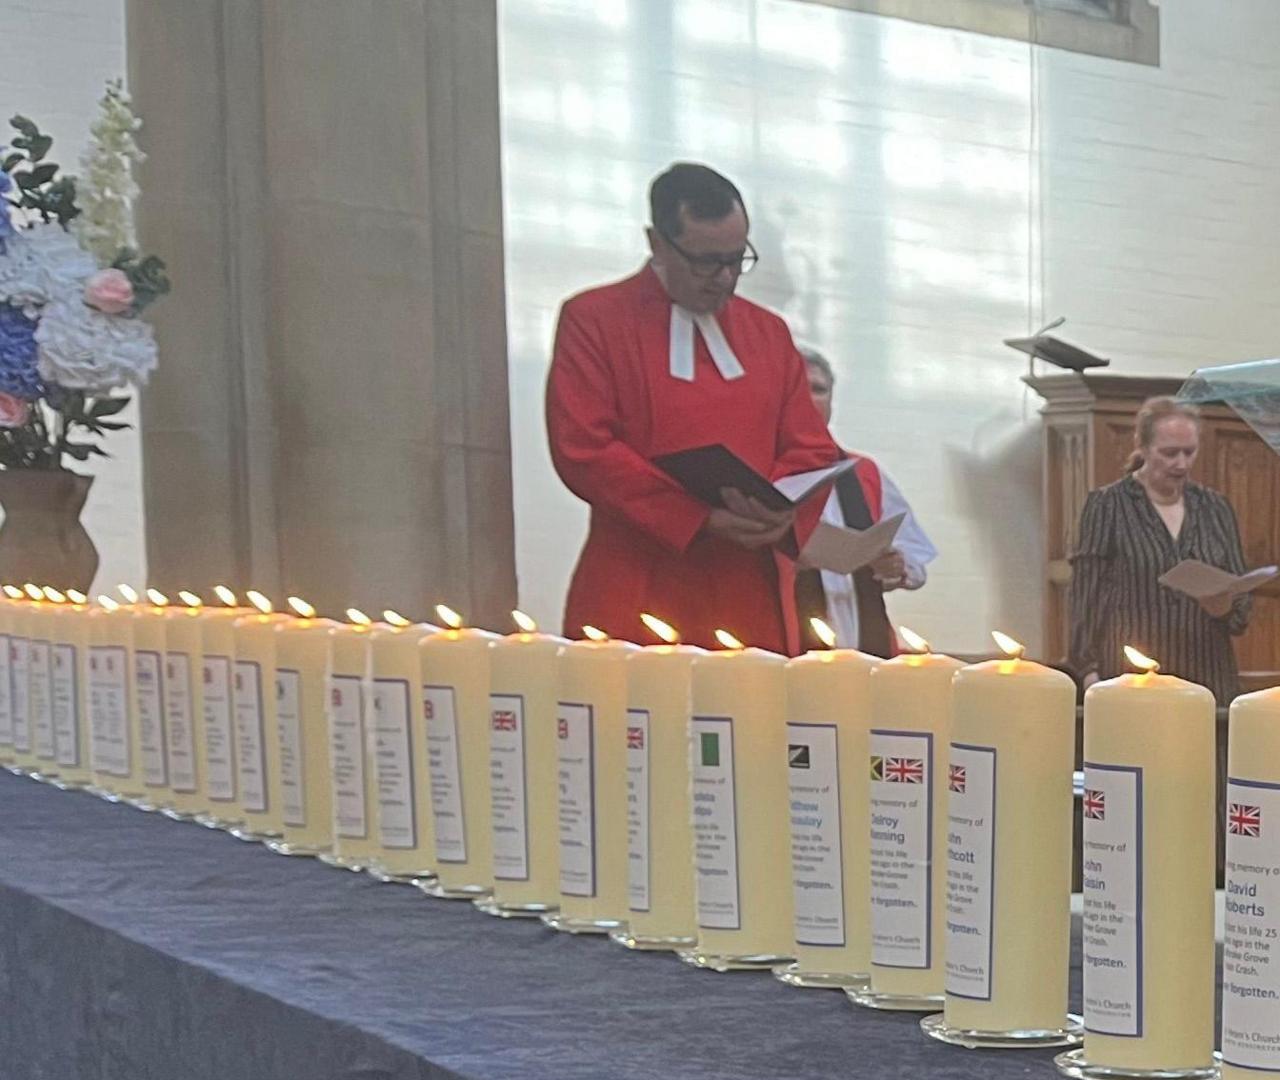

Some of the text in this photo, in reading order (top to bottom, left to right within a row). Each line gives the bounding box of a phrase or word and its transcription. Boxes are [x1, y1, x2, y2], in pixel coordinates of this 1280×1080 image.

[1227, 880, 1257, 897] David
[1265, 928, 1278, 938] 25
[1254, 940, 1270, 951] the
